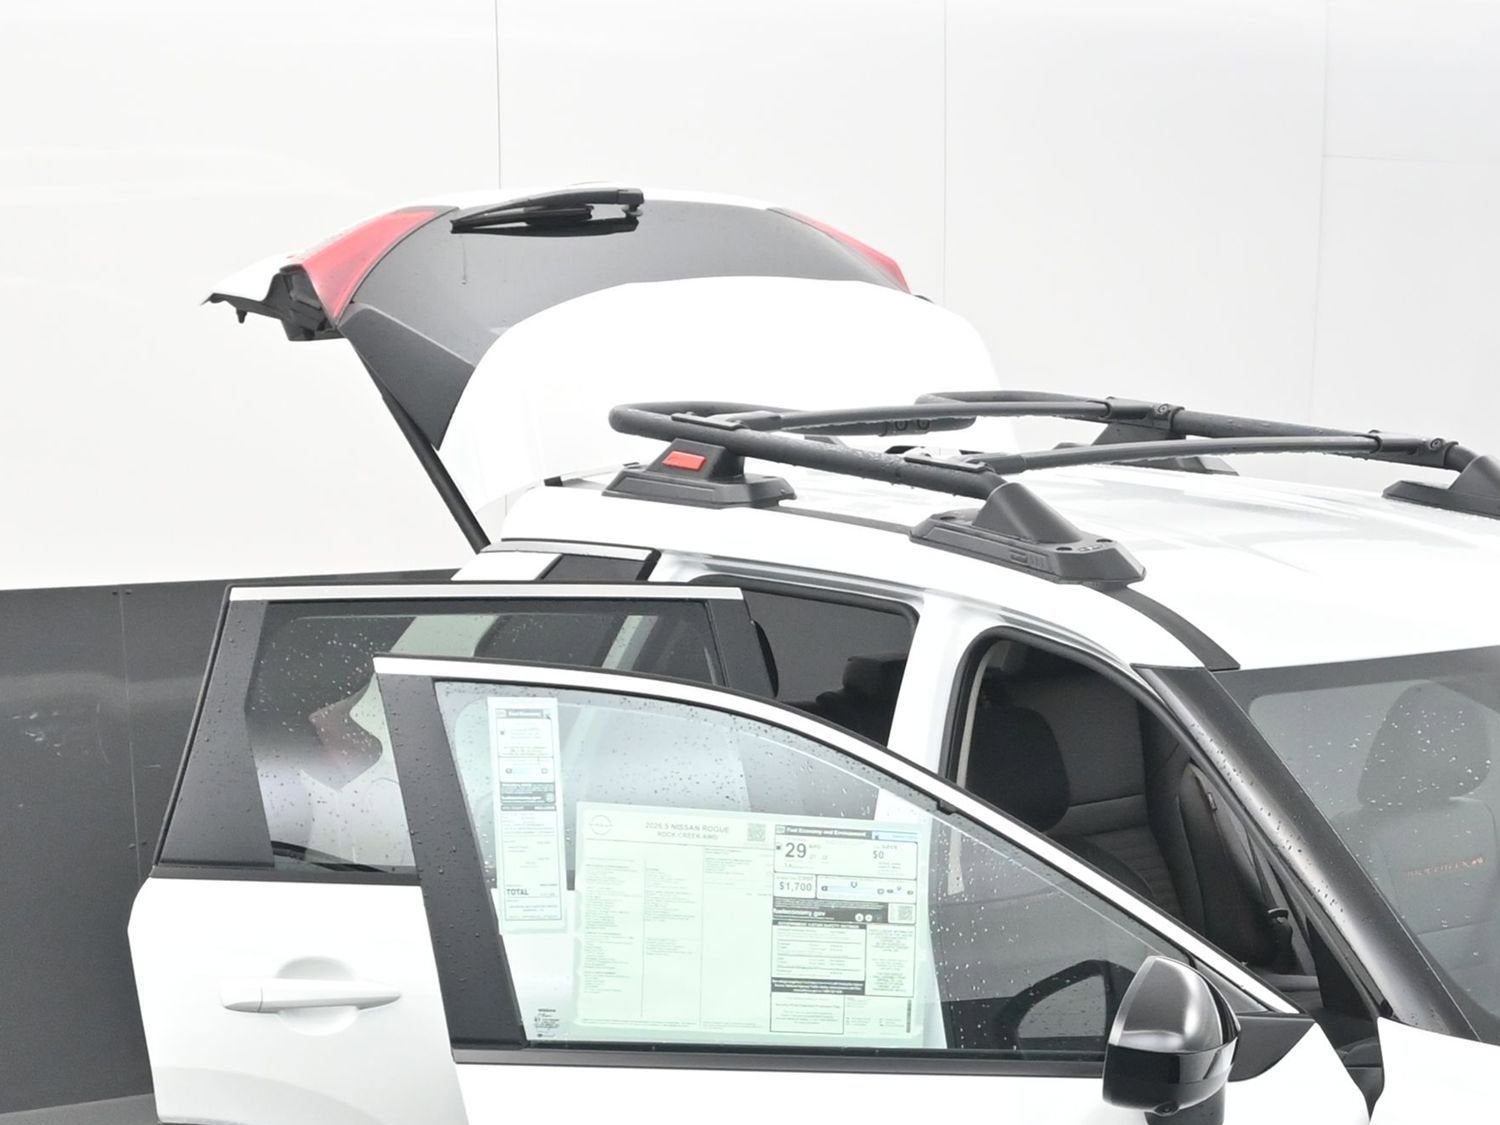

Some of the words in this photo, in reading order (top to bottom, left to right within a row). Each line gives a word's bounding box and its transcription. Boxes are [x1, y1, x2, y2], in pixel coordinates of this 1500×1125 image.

[671, 823, 700, 831] NISSAN
[702, 825, 730, 833] ROGUE
[785, 842, 807, 858] 29
[873, 850, 884, 859] $0
[779, 881, 812, 892] $1,700
[506, 888, 529, 896] TOTAL
